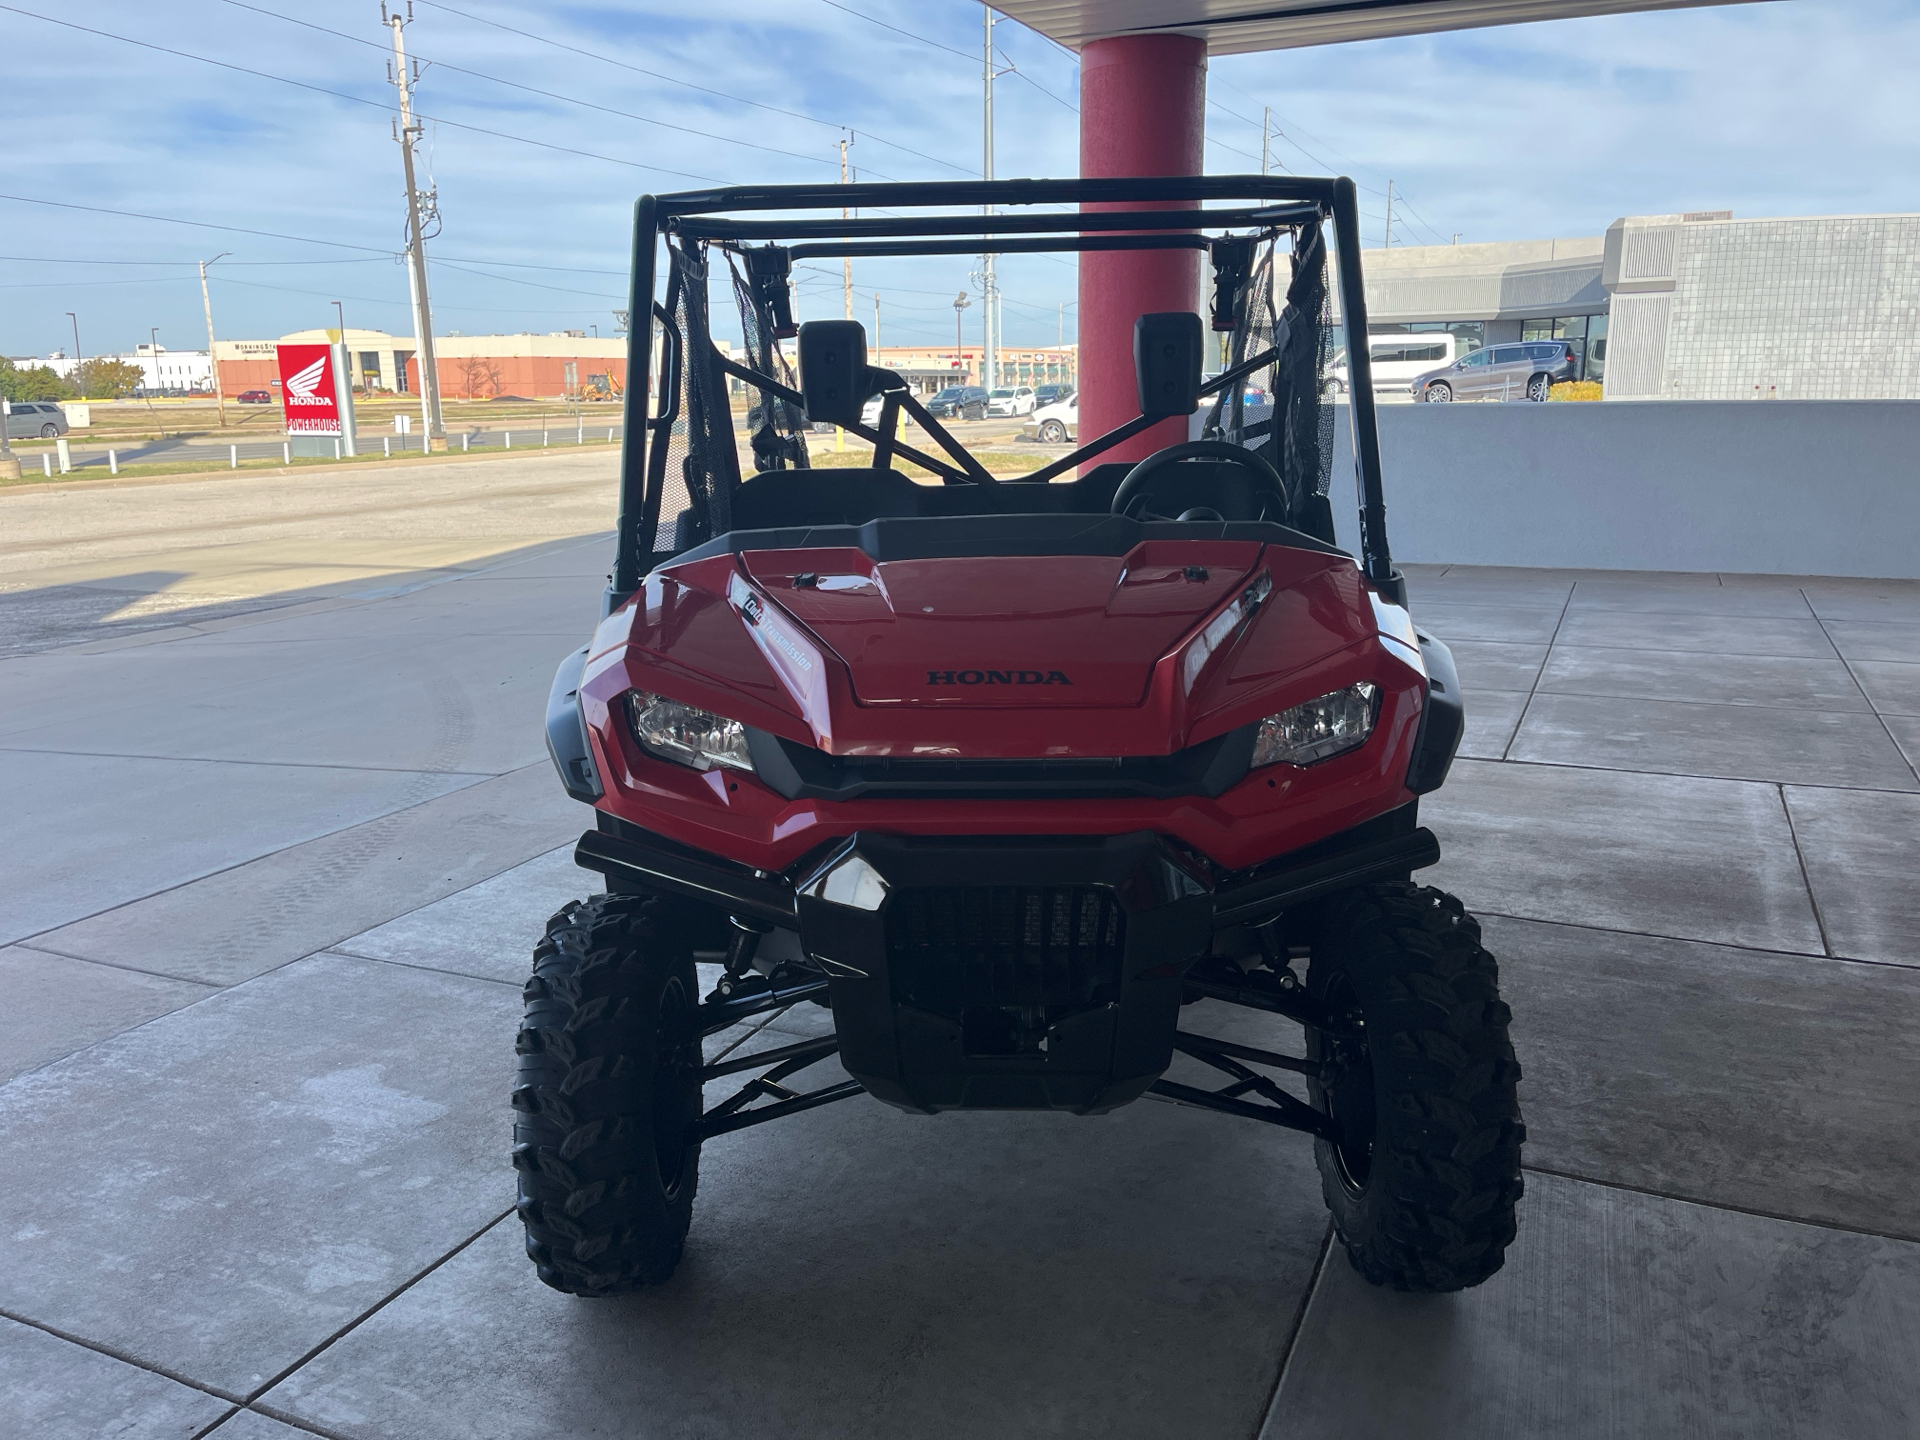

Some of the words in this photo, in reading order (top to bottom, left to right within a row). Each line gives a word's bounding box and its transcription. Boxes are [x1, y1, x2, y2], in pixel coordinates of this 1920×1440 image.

[289, 397, 333, 406] HONDA
[287, 418, 341, 431] POWERHOUSE
[745, 599, 767, 624] Clutch
[763, 618, 812, 671] Transmission
[926, 670, 1074, 685] HONDA
